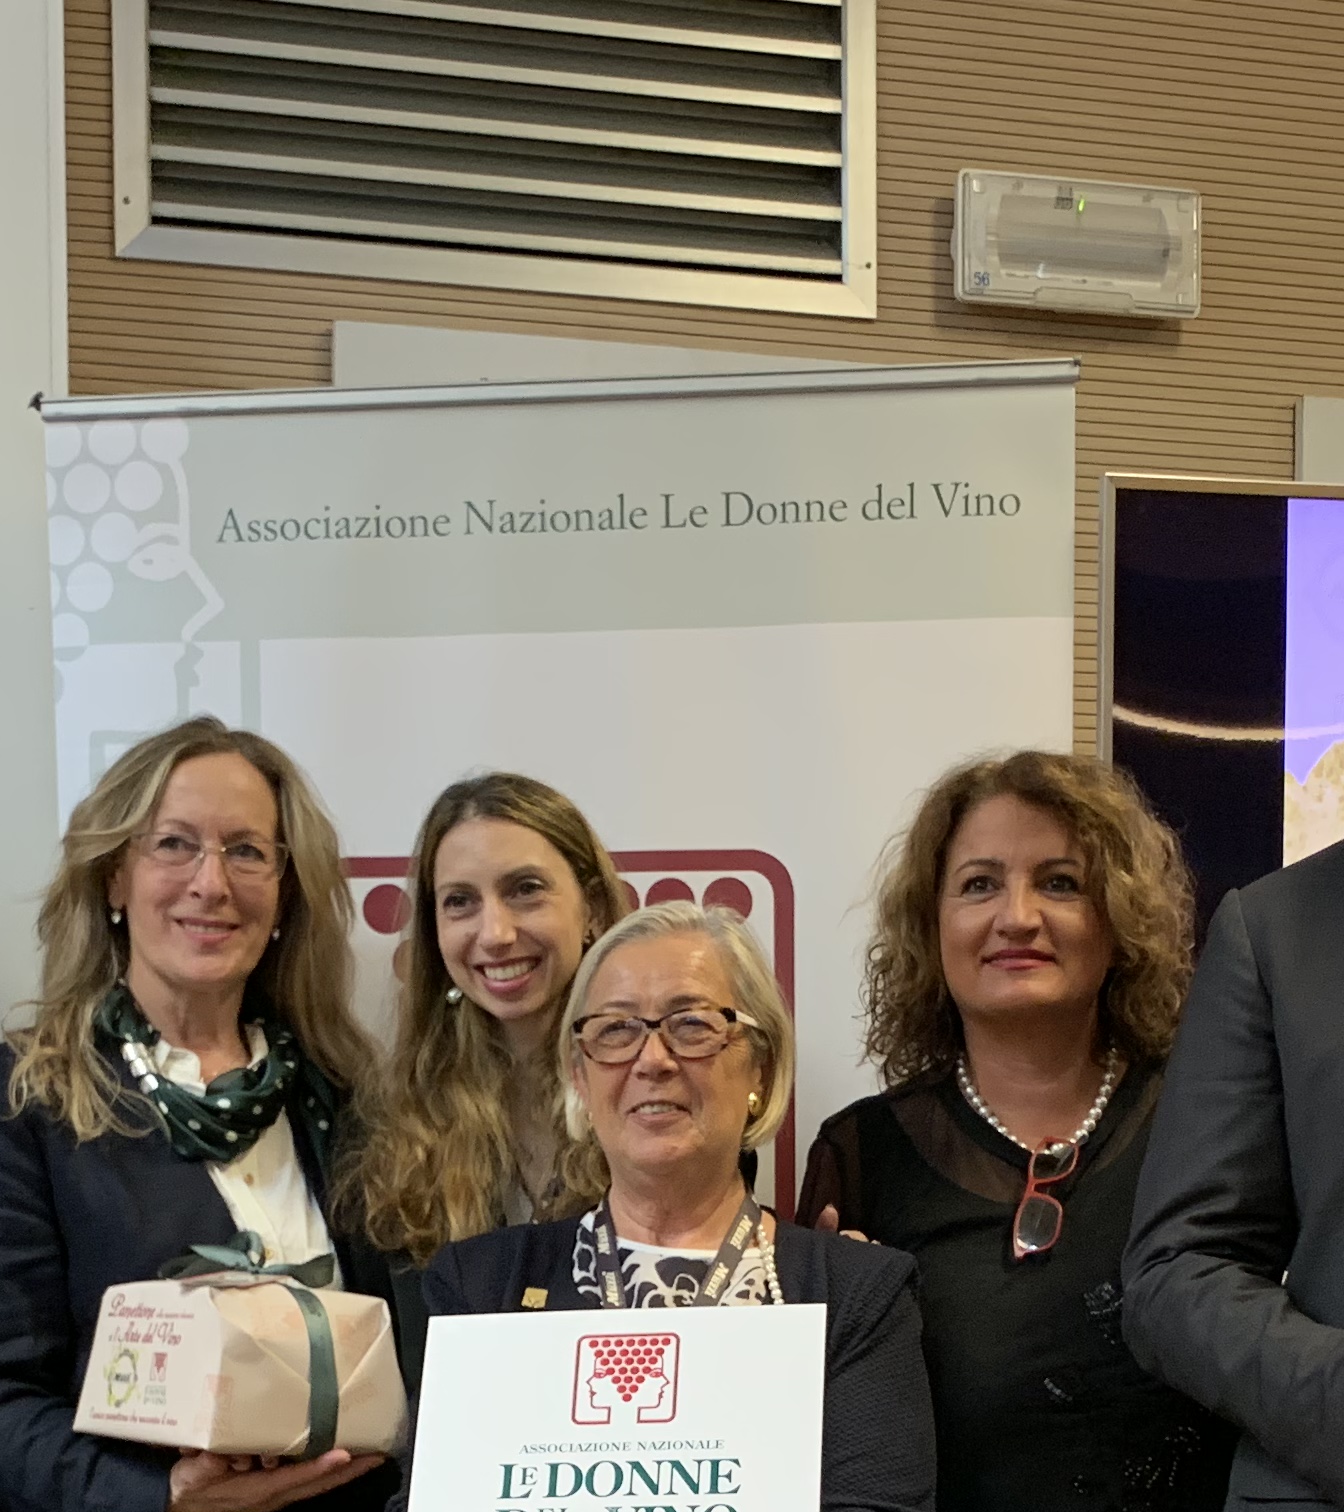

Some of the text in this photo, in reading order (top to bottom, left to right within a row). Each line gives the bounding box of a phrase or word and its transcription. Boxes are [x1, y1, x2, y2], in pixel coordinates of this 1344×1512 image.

[216, 482, 1022, 544] Associazione Nazionale Le Donne del Vino
[518, 1438, 726, 1456] ASSOCIAZIONE NAZIONALE
[542, 1457, 742, 1499] DONNE
